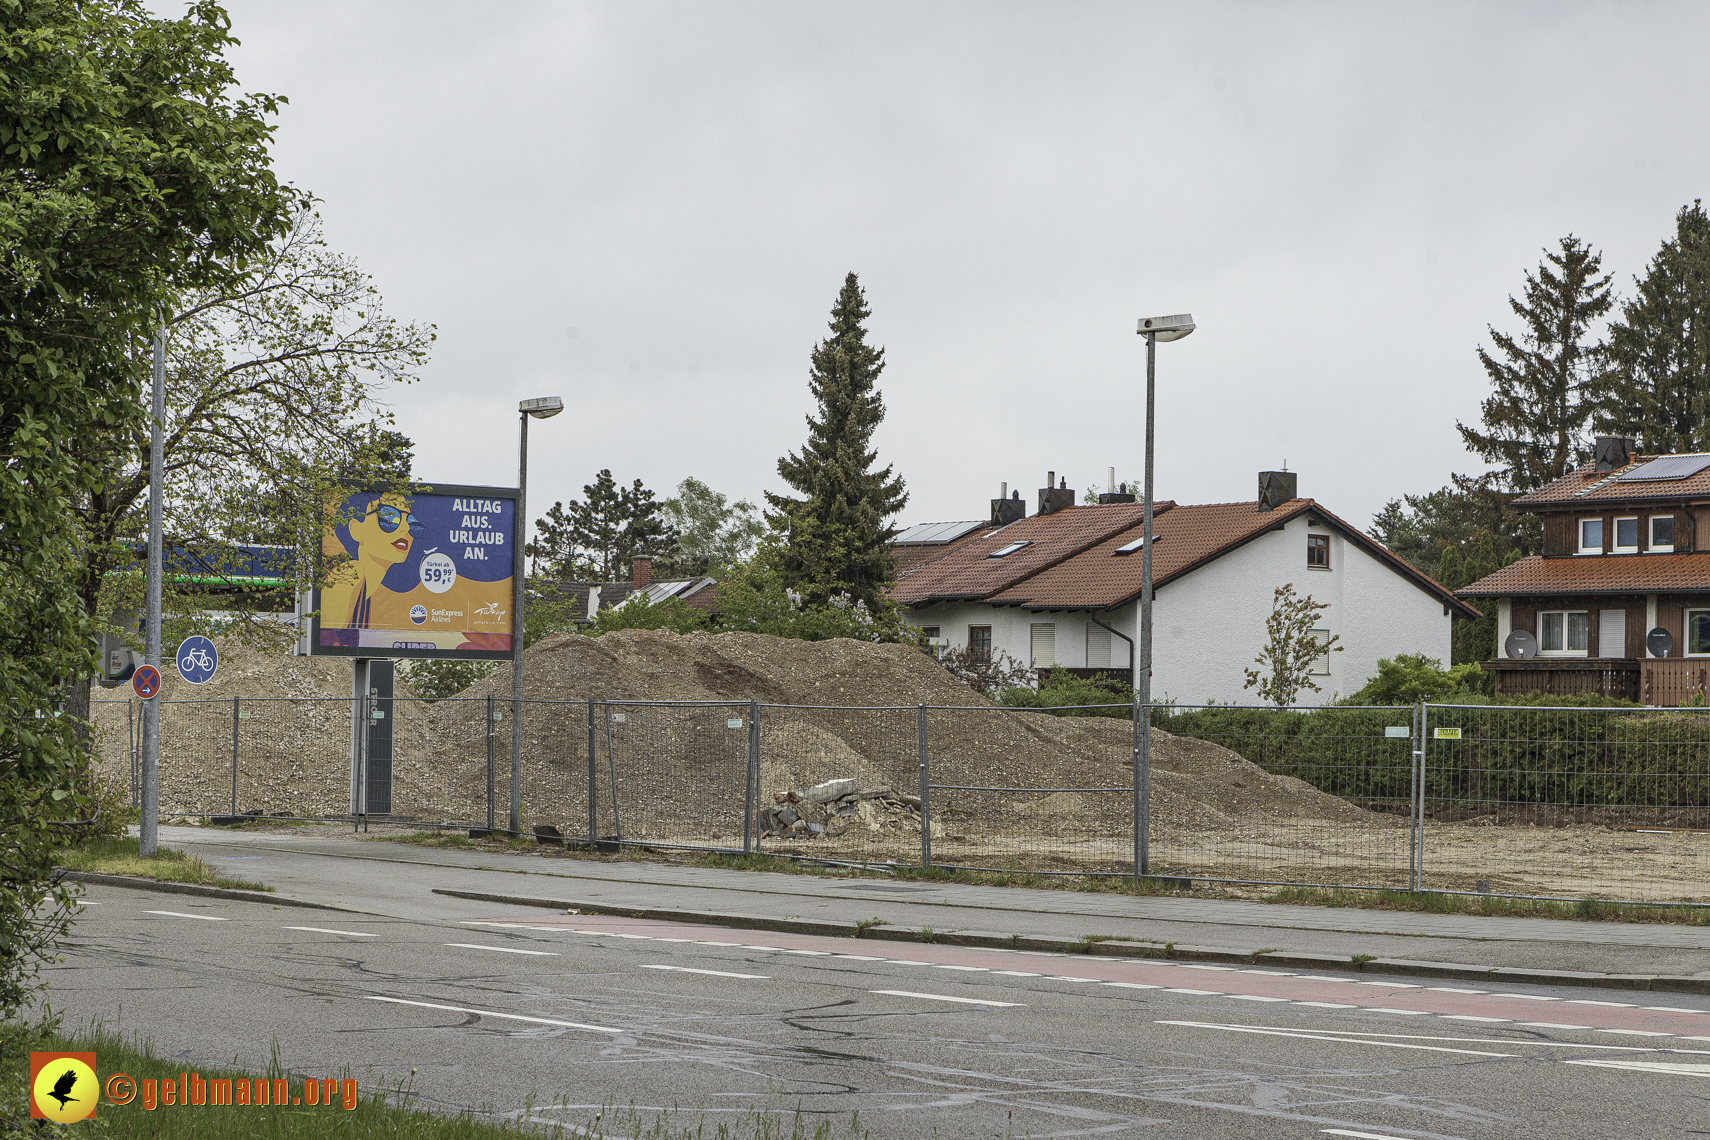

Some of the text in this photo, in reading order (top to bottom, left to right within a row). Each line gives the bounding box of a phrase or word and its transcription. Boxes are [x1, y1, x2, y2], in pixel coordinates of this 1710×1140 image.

[452, 498, 502, 513] ALLTAG
[461, 514, 492, 528] AUS.
[449, 529, 504, 545] URLAUB
[463, 546, 489, 560] AN.
[431, 608, 464, 618] SunExpress
